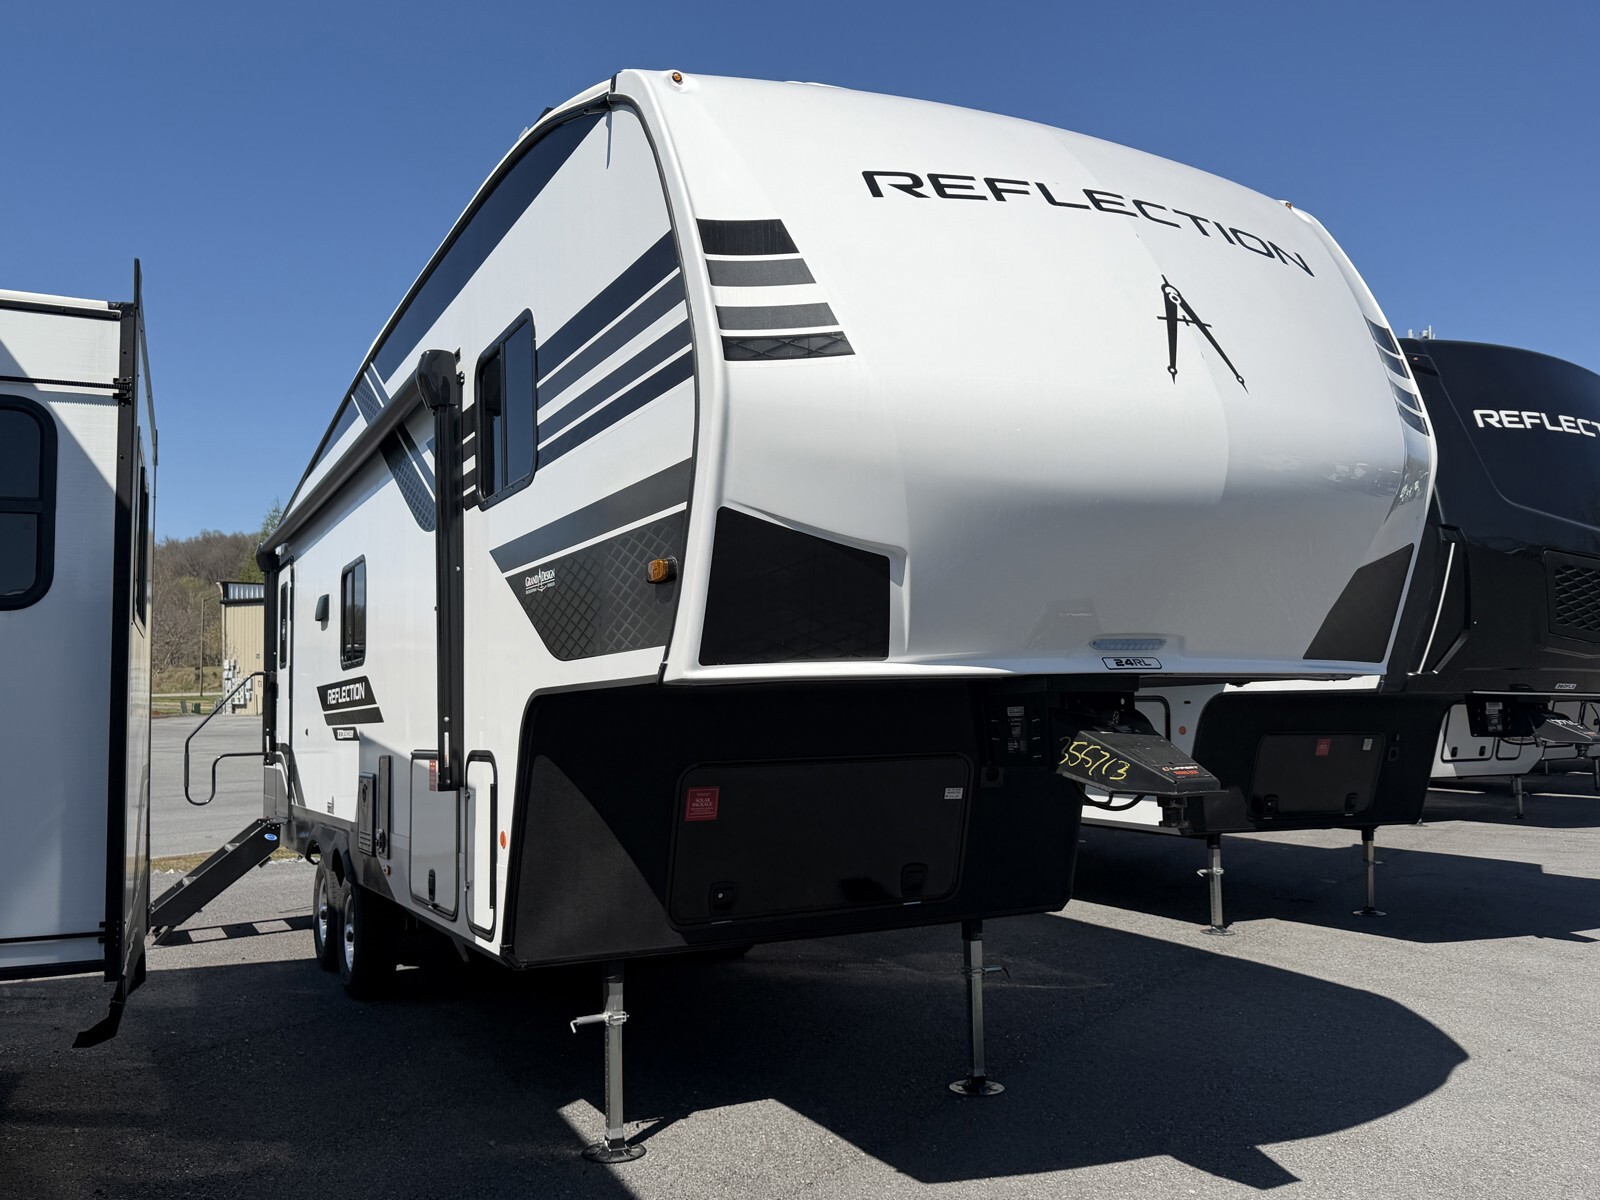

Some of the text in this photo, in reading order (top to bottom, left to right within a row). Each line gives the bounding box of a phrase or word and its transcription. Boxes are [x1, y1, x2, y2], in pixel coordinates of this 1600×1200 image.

[861, 170, 1315, 277] REFLECTION
[525, 574, 539, 586] GRAND
[541, 568, 556, 581] DESIGN
[1113, 658, 1152, 667] 24RL
[327, 682, 365, 705] REFLECTION
